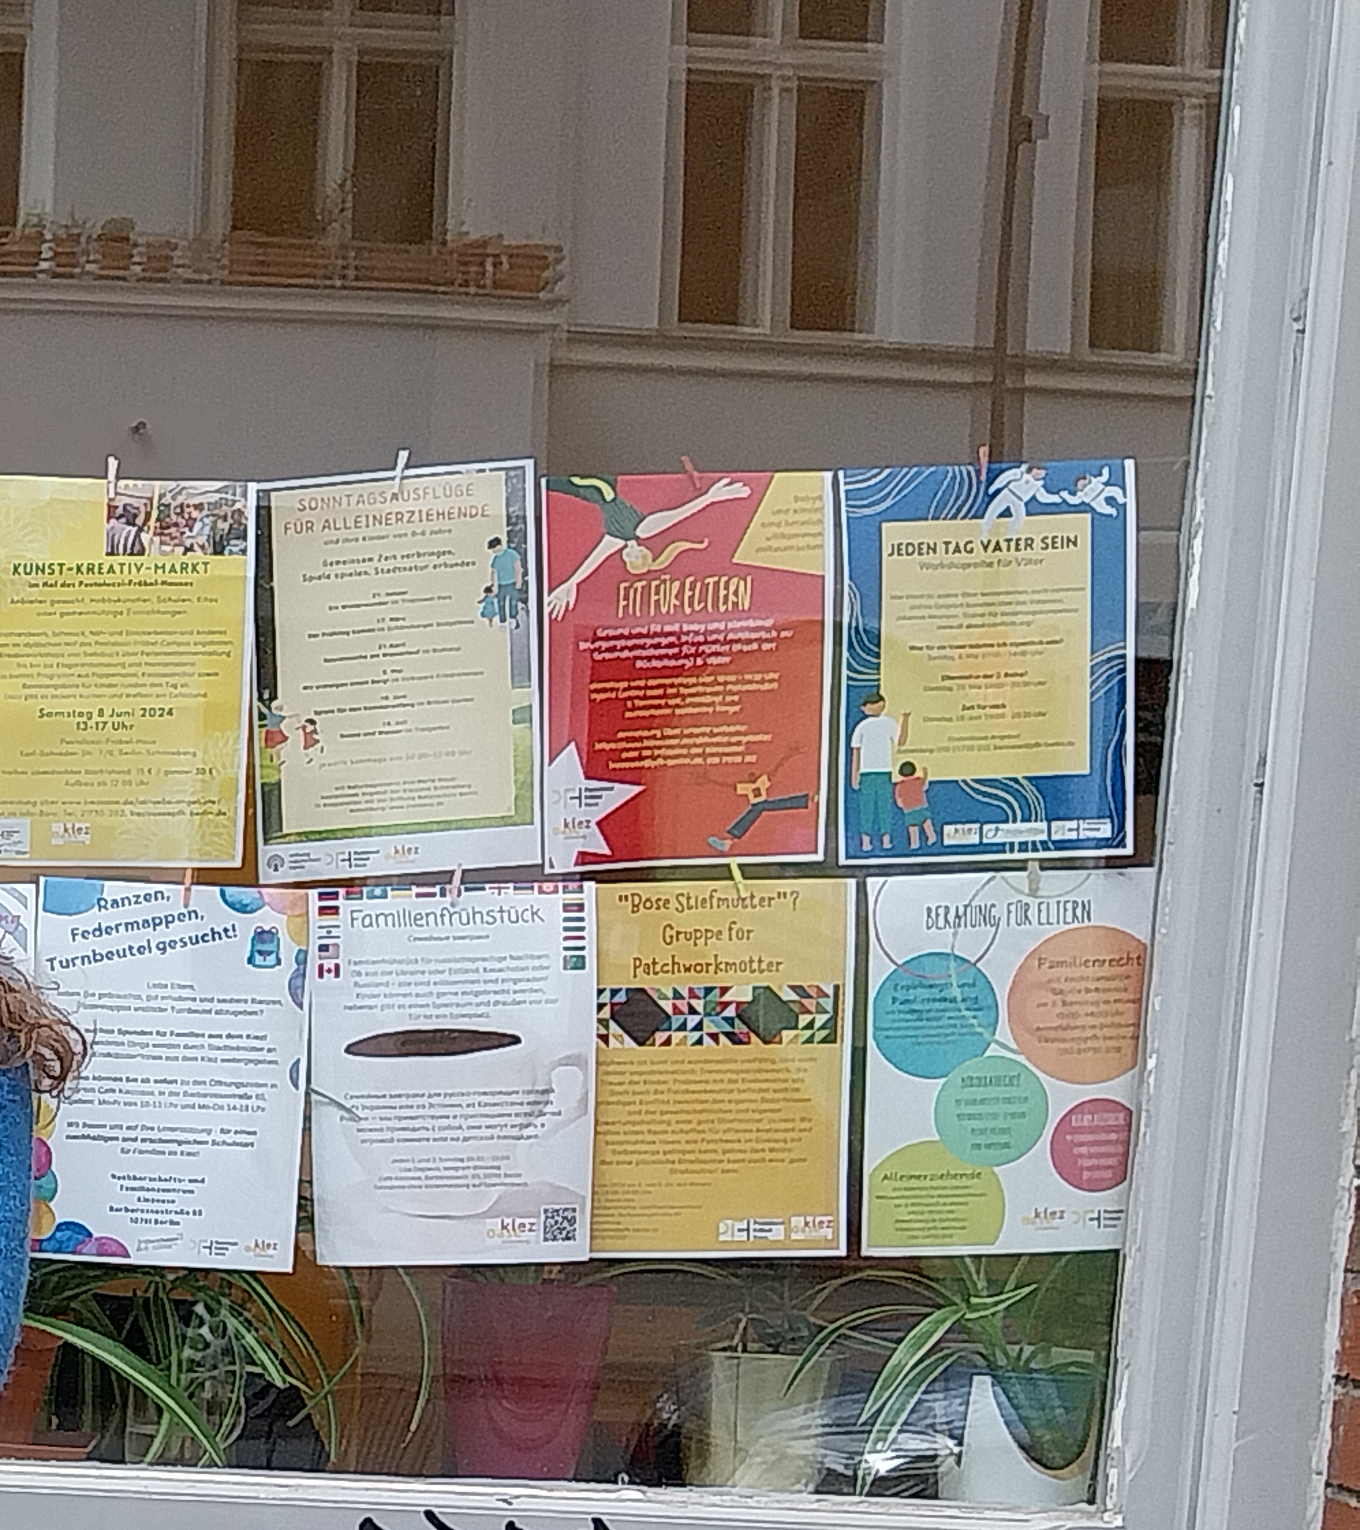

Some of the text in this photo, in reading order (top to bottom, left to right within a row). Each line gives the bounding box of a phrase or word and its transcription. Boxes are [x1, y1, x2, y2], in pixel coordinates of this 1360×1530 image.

[297, 483, 475, 513] SONNTAGSAUSFLÜGE
[283, 503, 490, 535] FÜR ALLEINERZIEHENDE
[888, 534, 1078, 557] JEDEN TAG VATER SEIN
[12, 562, 210, 576] KUNST-KREATIV-MARKT
[997, 558, 1012, 567] für
[617, 575, 752, 618] FIT FÜR ELTERN
[38, 708, 93, 720] Samstag
[109, 708, 135, 718] Juni
[140, 708, 174, 717] 2024
[76, 721, 134, 731] 13-17 Uhr
[97, 889, 171, 913] Ranzen,
[70, 909, 205, 943] Federmappen,
[349, 904, 545, 929] Familienfrühstück
[925, 899, 1092, 930] BERATUNG FÜR ELTERN
[662, 923, 723, 947] Gruppe
[46, 923, 238, 972] Turnbeutel gesucht!
